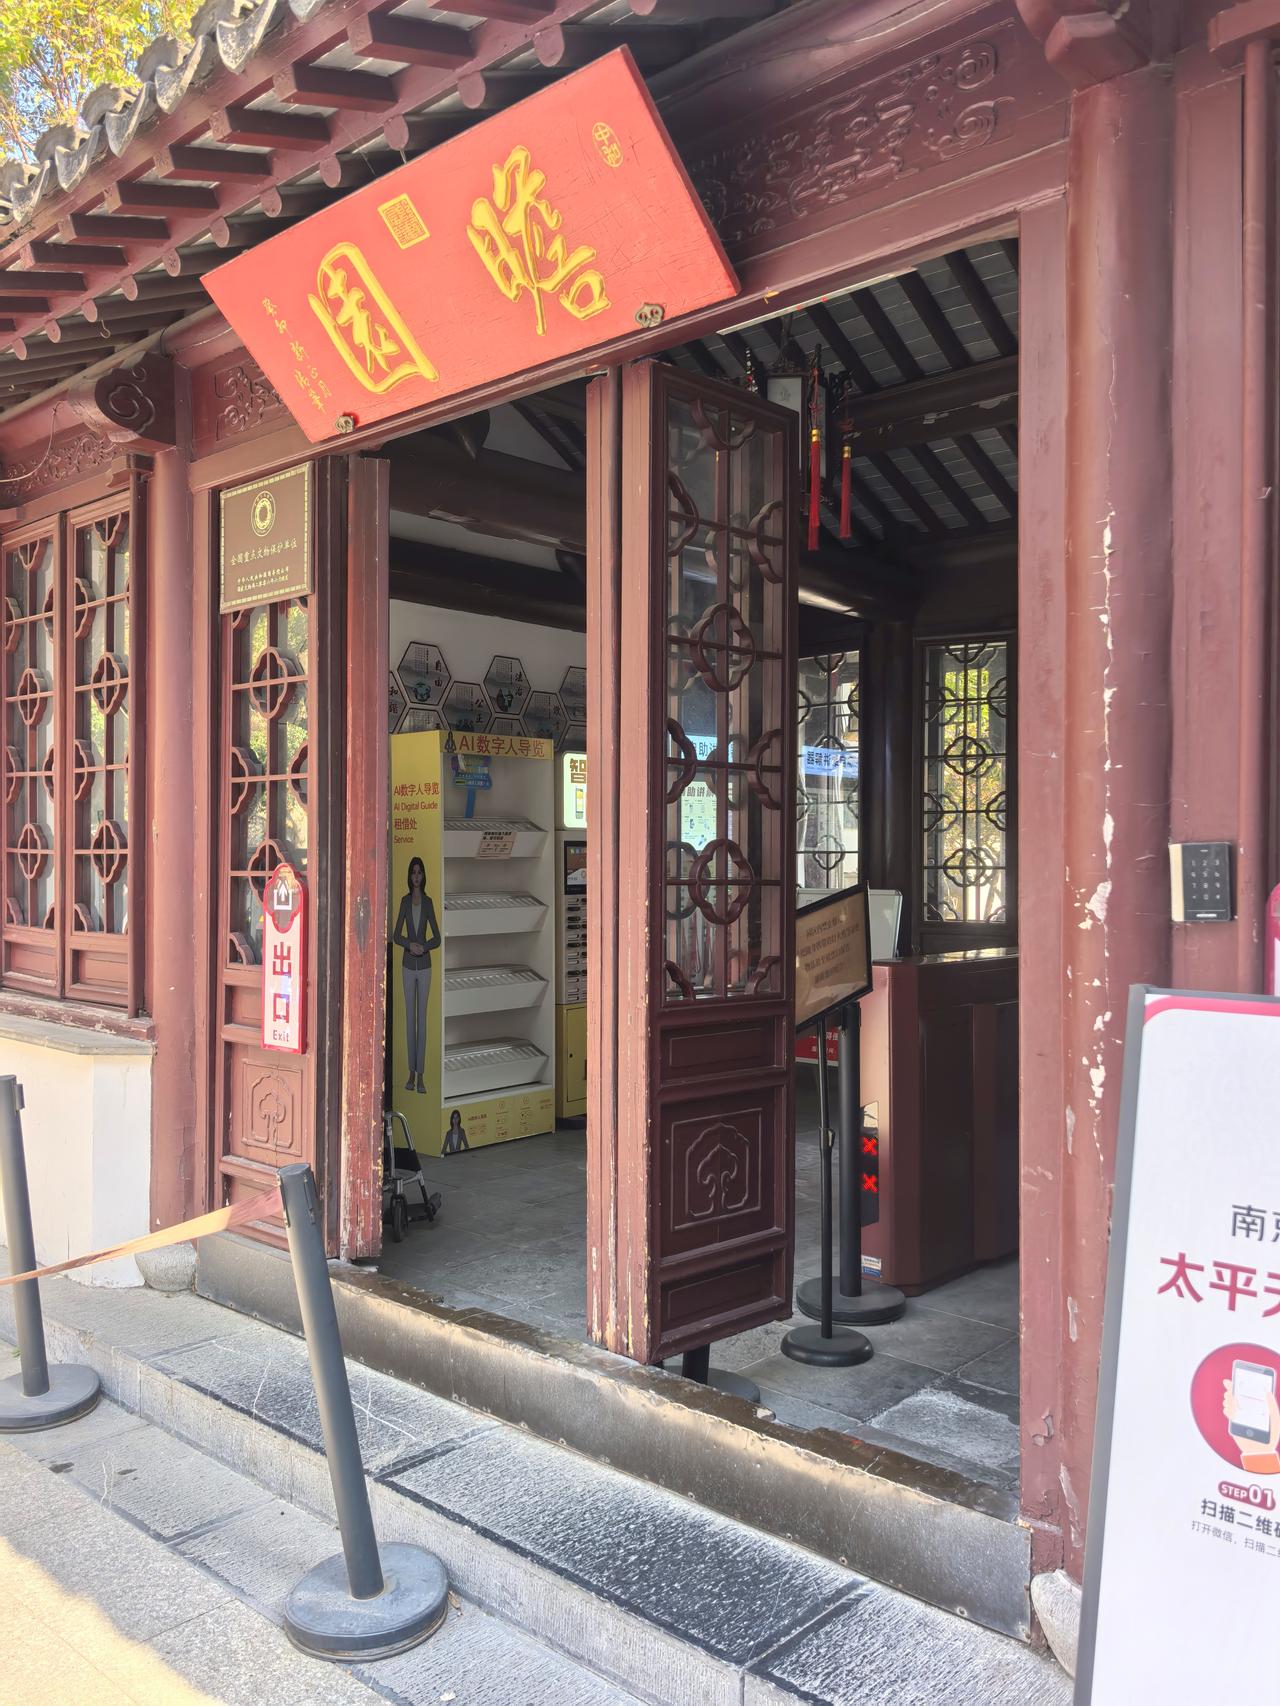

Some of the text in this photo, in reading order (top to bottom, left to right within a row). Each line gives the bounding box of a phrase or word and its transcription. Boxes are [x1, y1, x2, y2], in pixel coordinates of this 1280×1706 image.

[459, 735, 545, 757] AI数字人导览
[394, 783, 440, 796] AI数字人导览
[394, 801, 438, 812] AI Digital Guide
[394, 817, 417, 830] 租借处
[394, 835, 414, 844] Service
[272, 941, 292, 1024] 出口
[272, 1029, 290, 1042] Exit
